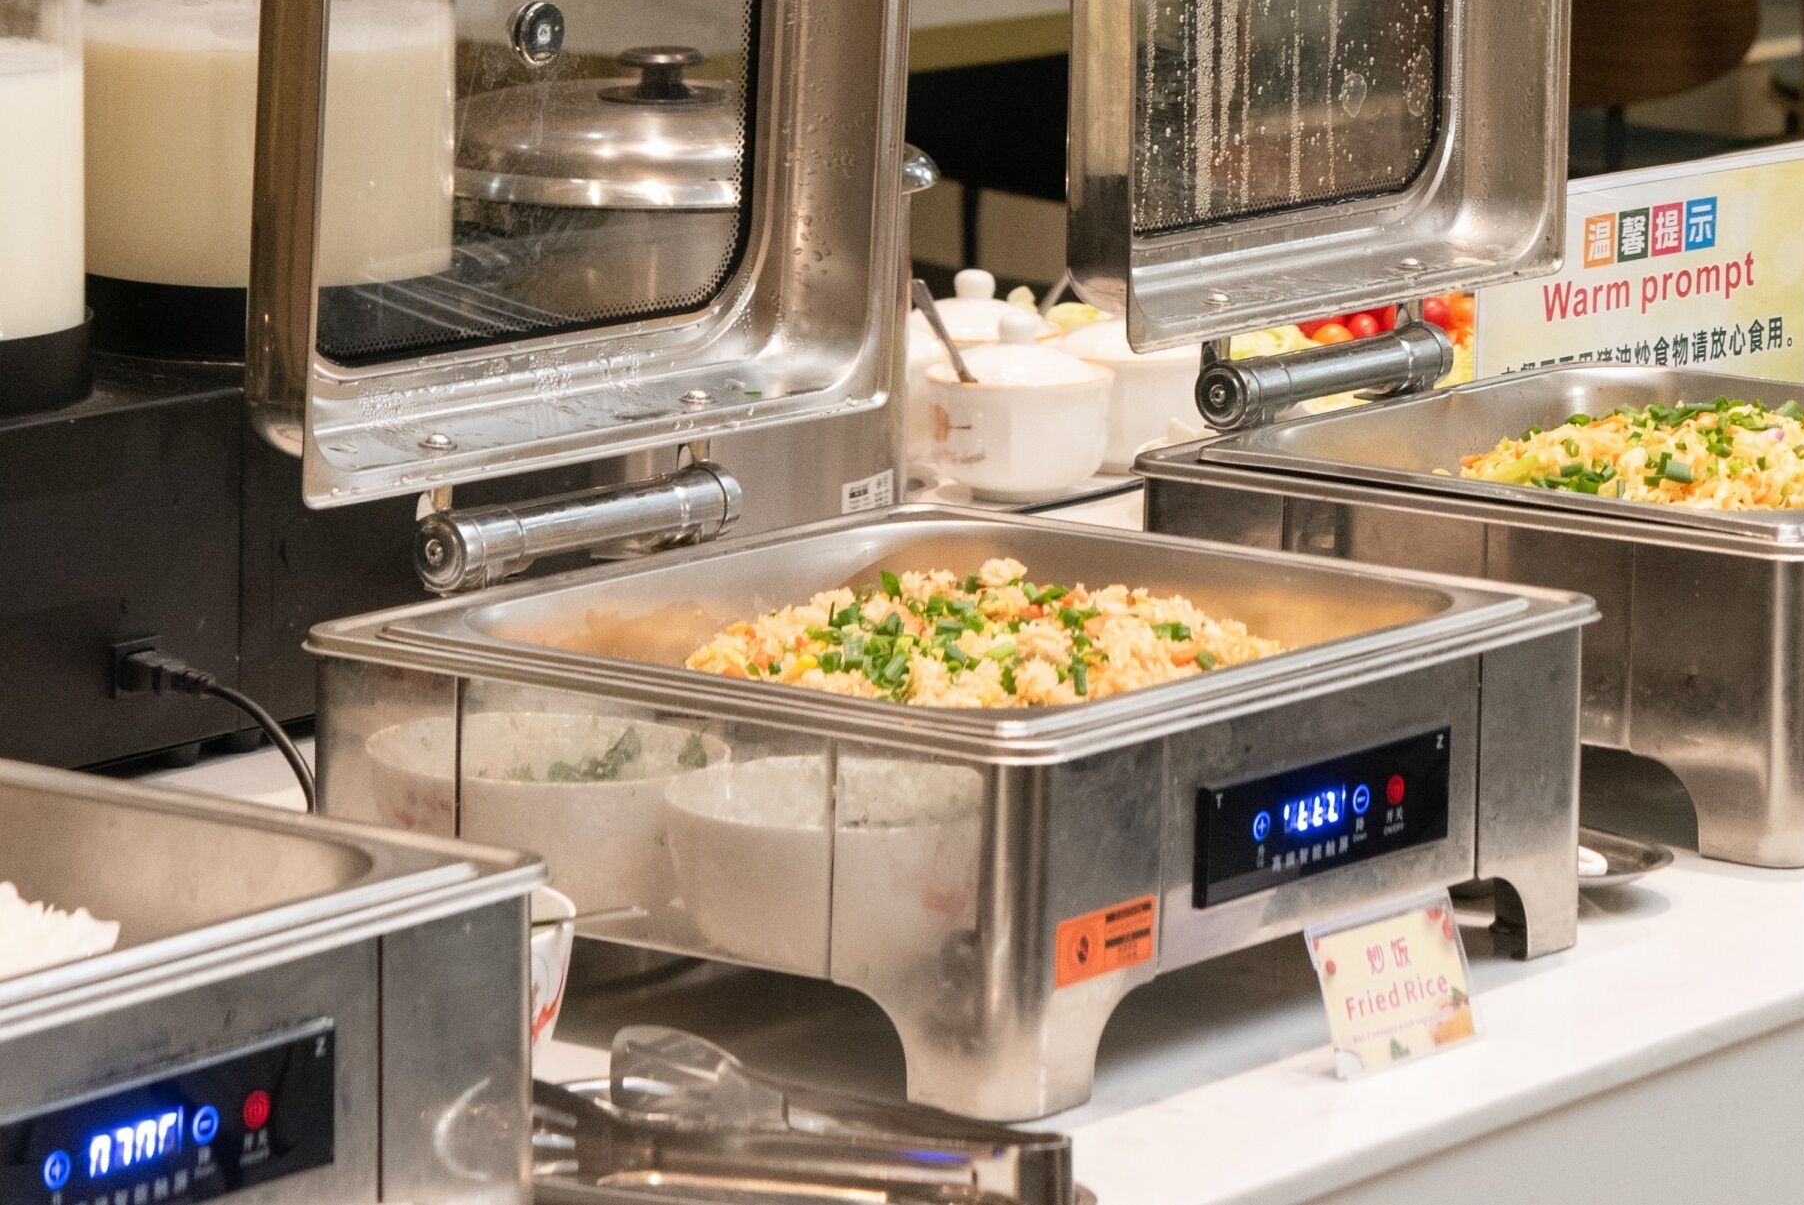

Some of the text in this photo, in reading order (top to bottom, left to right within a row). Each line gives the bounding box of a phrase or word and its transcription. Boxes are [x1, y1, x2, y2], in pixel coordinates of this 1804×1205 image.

[1586, 204, 1714, 262] 温馨提示
[1543, 250, 1756, 323] Warm prompt
[1500, 315, 1794, 376] 猪油炒食物请放心食用。
[1435, 733, 1444, 750] Z
[1215, 793, 1223, 809] T
[1366, 936, 1411, 976] 炒饭
[1345, 982, 1400, 1021] Fried
[1403, 974, 1449, 1005] Rice
